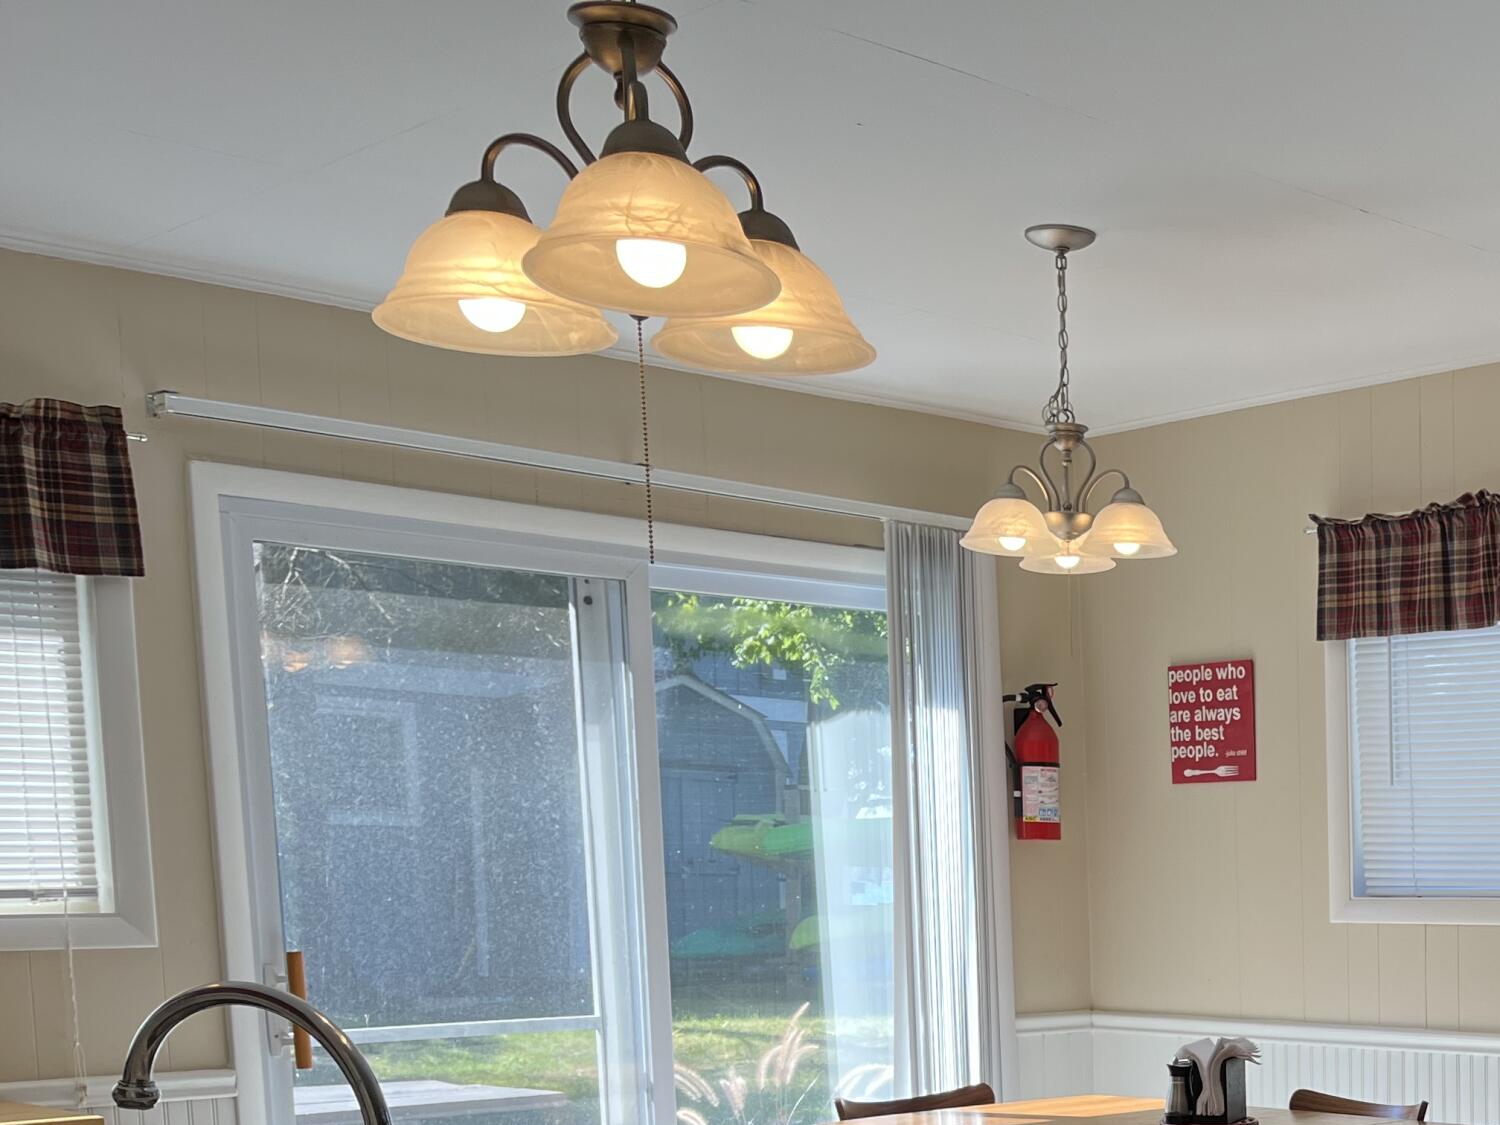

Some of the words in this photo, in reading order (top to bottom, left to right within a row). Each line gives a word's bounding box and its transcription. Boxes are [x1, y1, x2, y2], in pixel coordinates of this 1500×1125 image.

[1168, 665, 1212, 687] people
[1216, 663, 1246, 680] who
[1169, 688, 1196, 704] love
[1199, 687, 1213, 703] to
[1216, 684, 1238, 701] eat
[1170, 709, 1191, 723] are
[1194, 705, 1241, 724] always
[1170, 726, 1191, 742] the
[1195, 725, 1225, 741] best
[1171, 741, 1219, 762] people.
